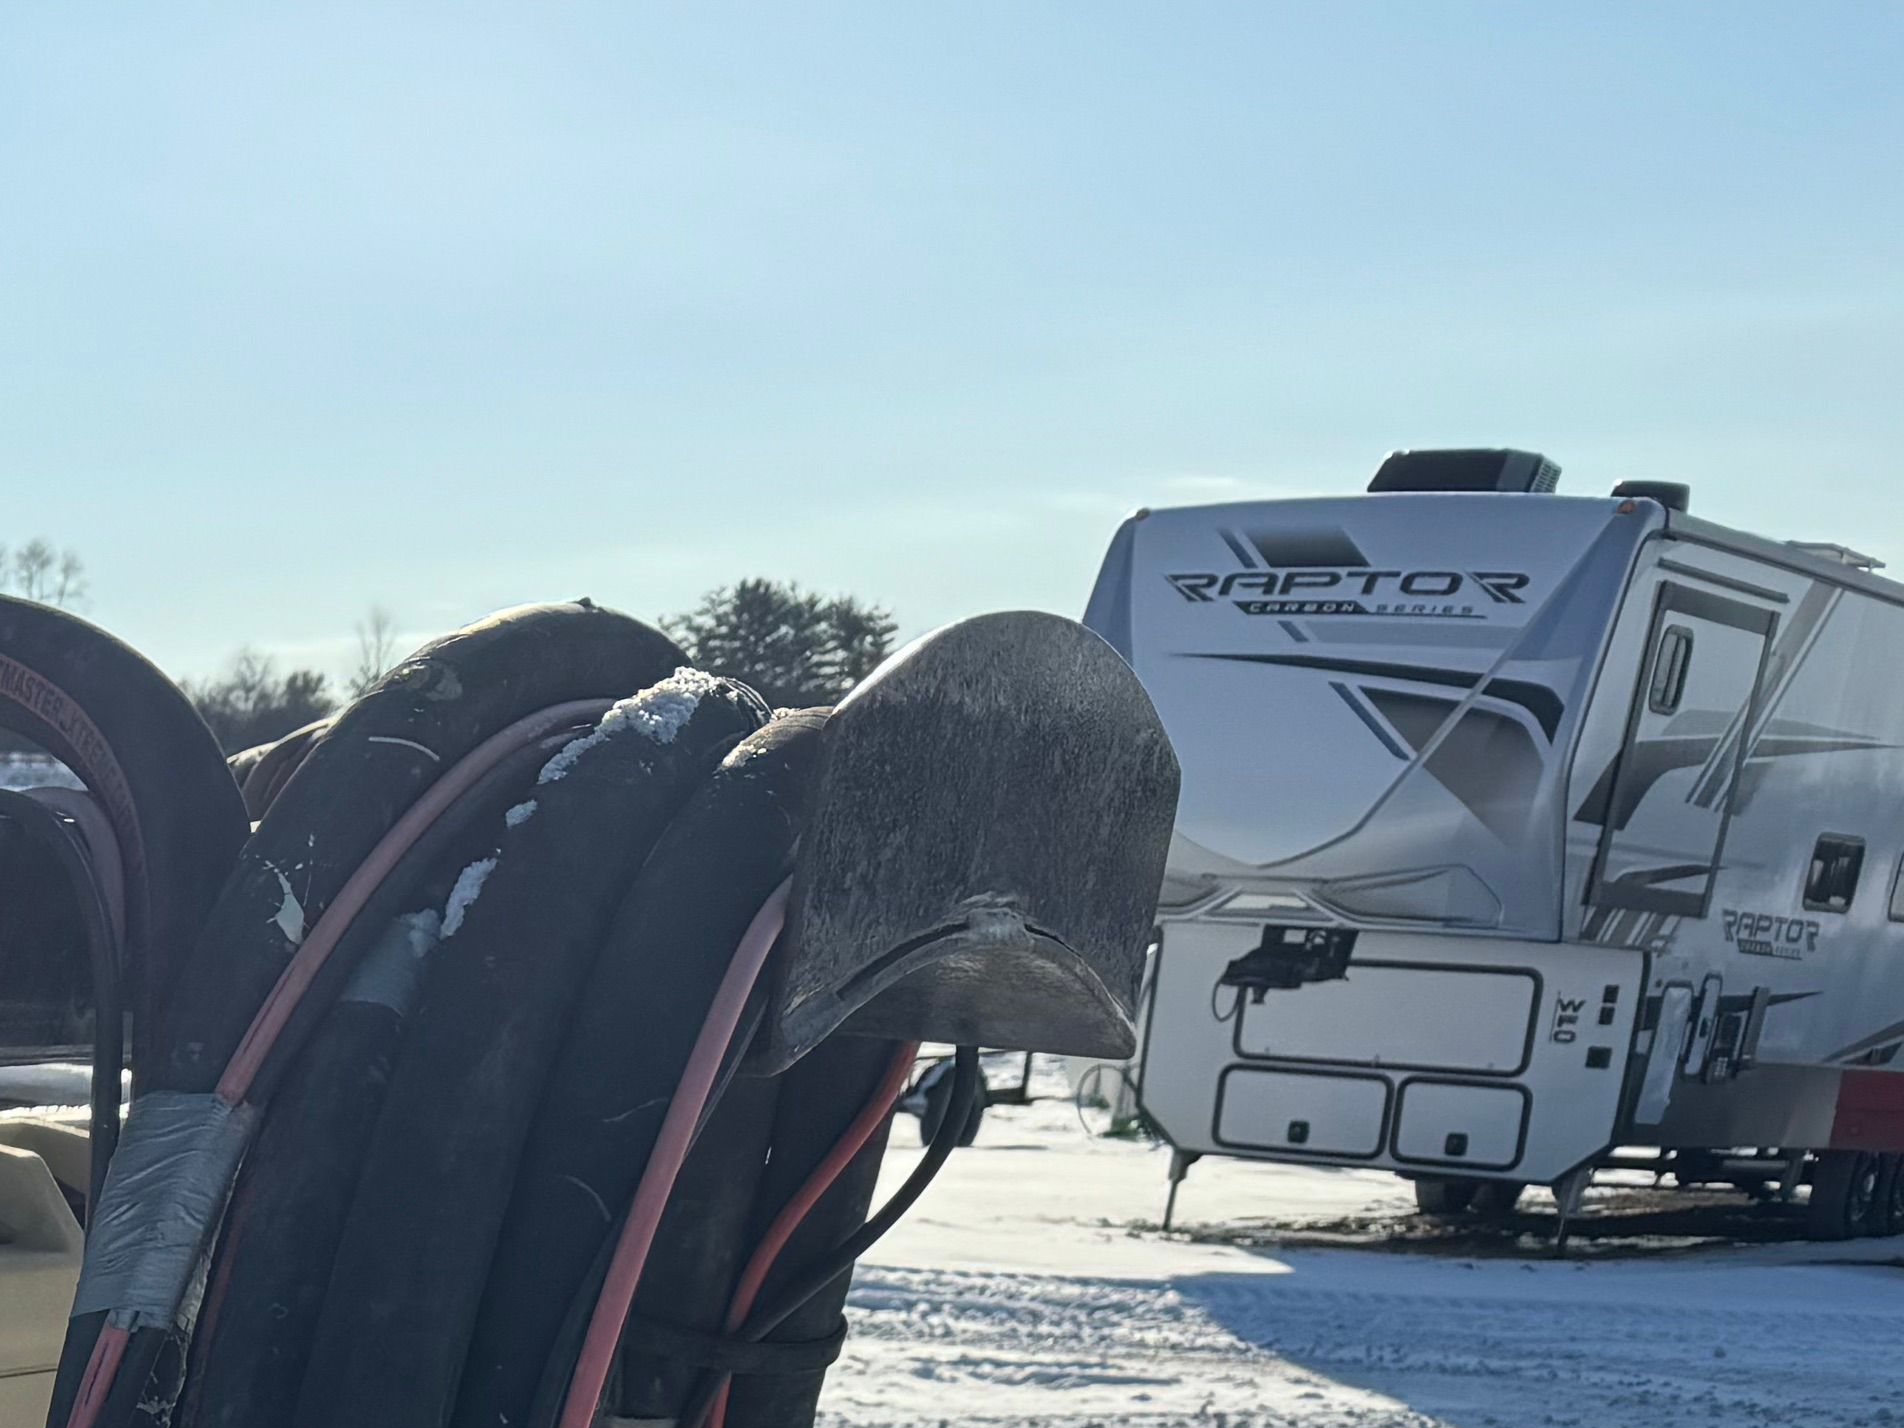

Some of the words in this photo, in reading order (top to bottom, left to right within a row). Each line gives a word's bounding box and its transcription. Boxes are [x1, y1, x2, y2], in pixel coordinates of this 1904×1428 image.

[1163, 570, 1531, 604] RAPTOR
[1248, 601, 1356, 614] CARBON
[1376, 603, 1475, 616] SERIES
[1722, 908, 1821, 953] RAPTOR
